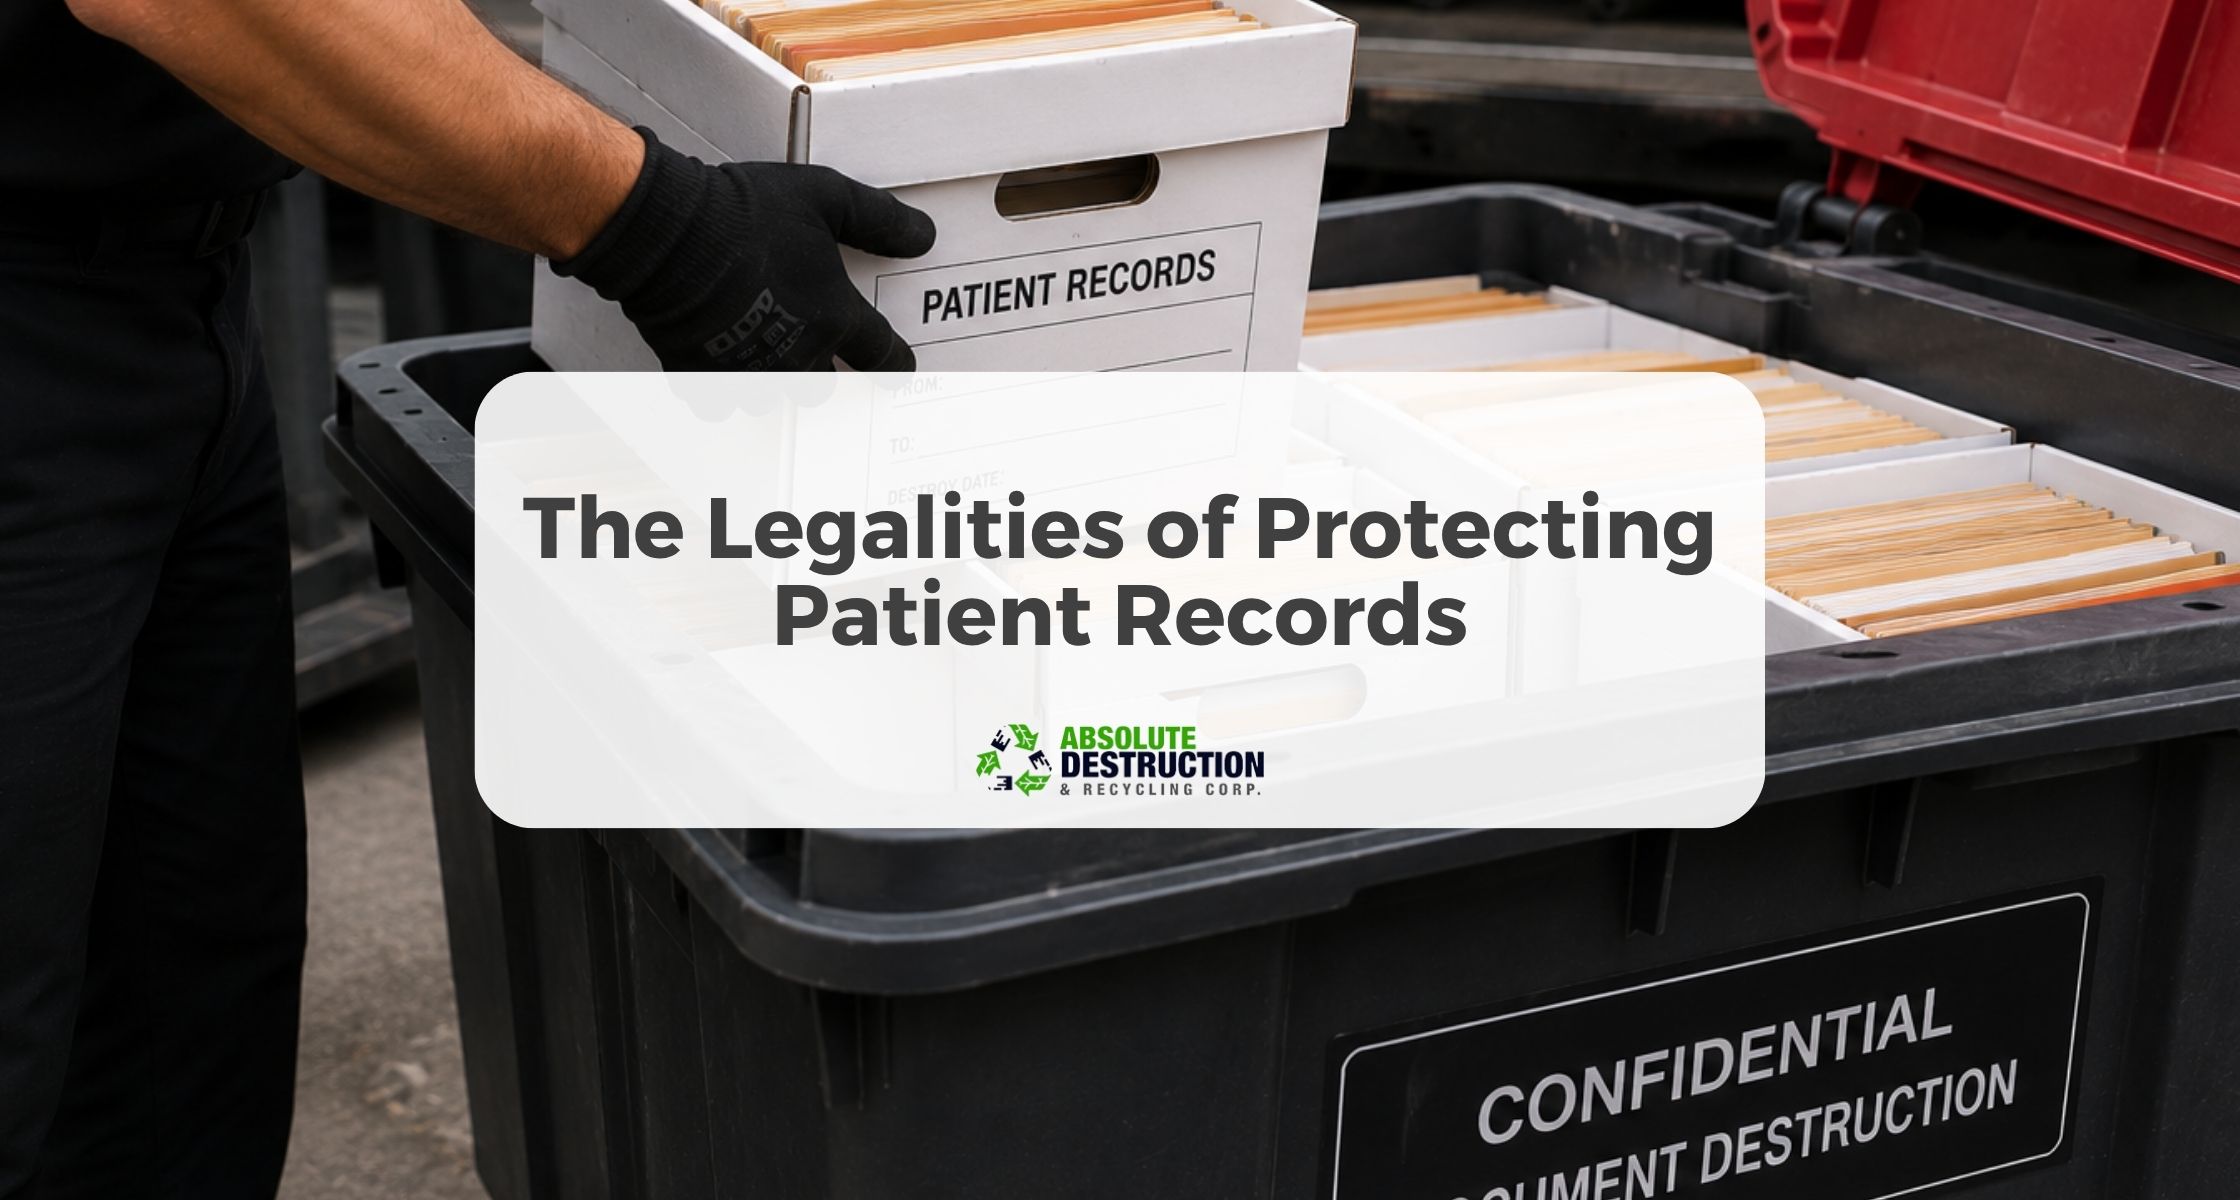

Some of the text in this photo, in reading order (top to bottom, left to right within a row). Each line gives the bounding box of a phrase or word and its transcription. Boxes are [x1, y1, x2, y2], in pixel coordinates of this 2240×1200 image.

[922, 249, 1217, 324] PATIENT RECORDS
[889, 436, 915, 455] TO:
[962, 469, 1005, 493] DATE:
[1478, 988, 1953, 1145] CONFIDENTIAL
[1450, 1058, 2019, 1200] MENT DESTRUCTION
